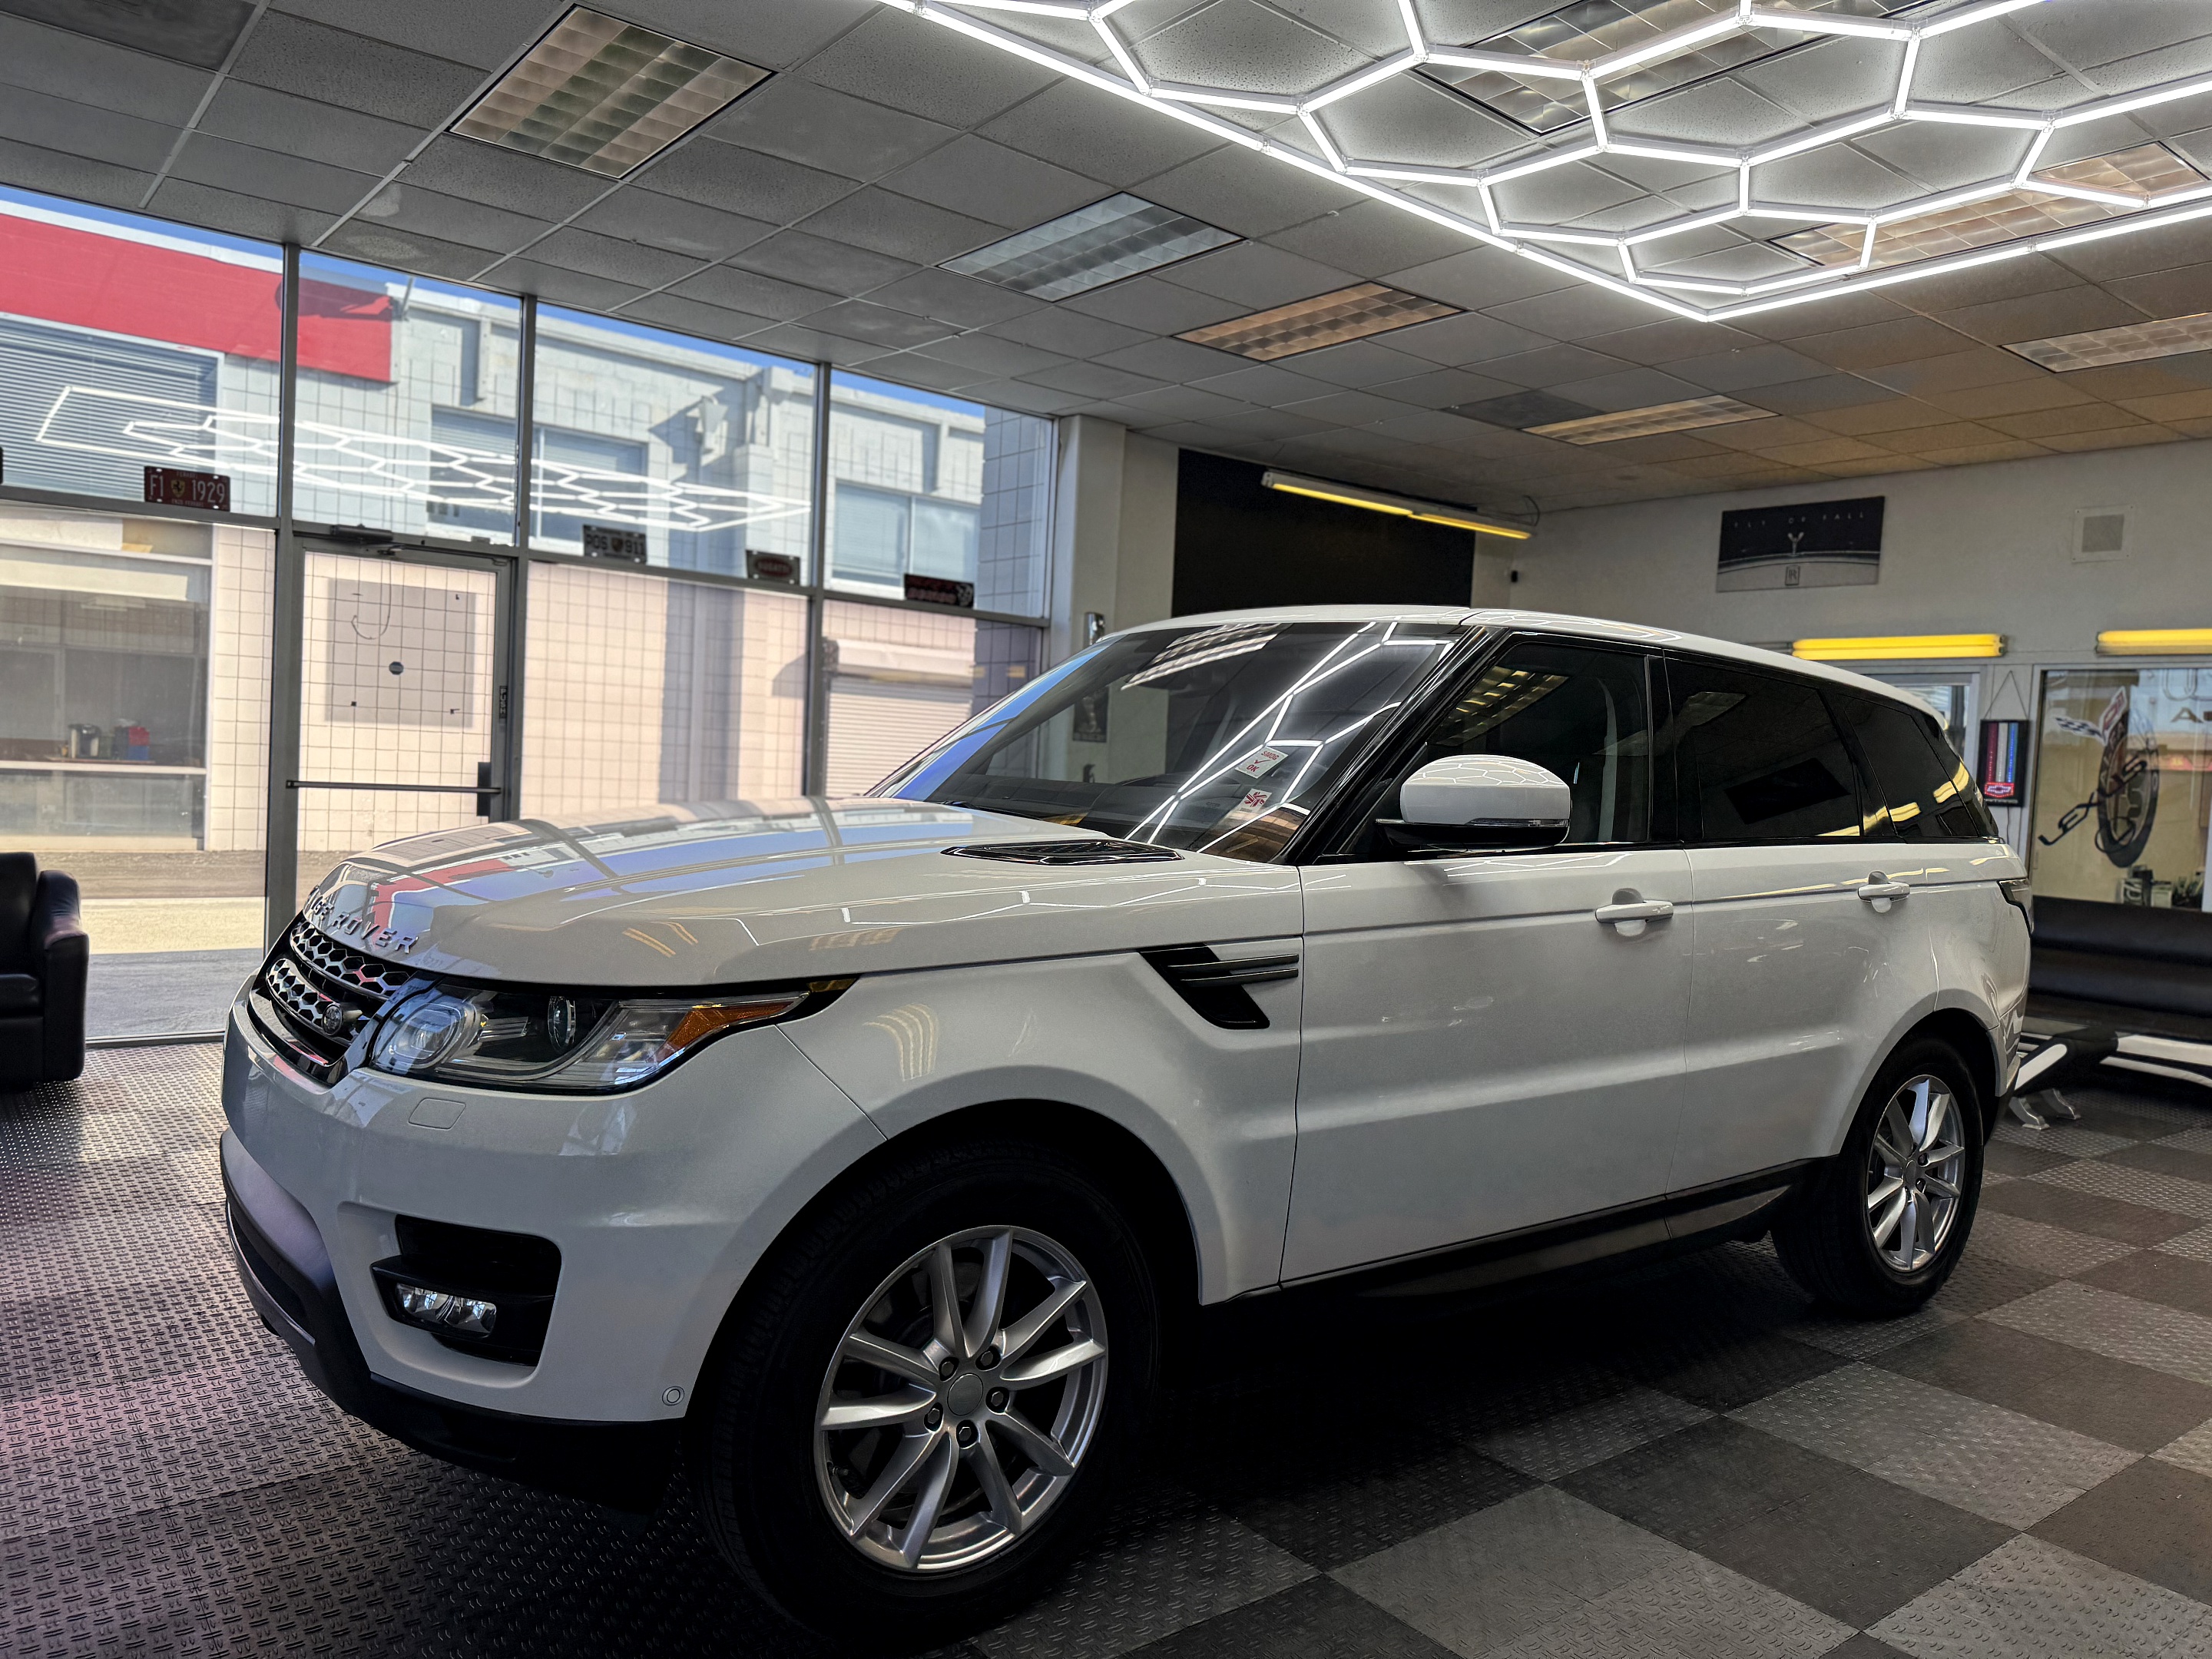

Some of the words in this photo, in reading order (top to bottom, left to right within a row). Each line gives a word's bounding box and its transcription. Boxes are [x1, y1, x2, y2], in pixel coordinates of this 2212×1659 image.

[150, 474, 164, 498] F1
[191, 478, 226, 504] 1929
[586, 533, 608, 550] POS
[624, 539, 646, 556] 911
[1260, 750, 1280, 761] SMOG
[2037, 754, 2147, 846] LEXUS
[331, 911, 419, 954] ROVER
